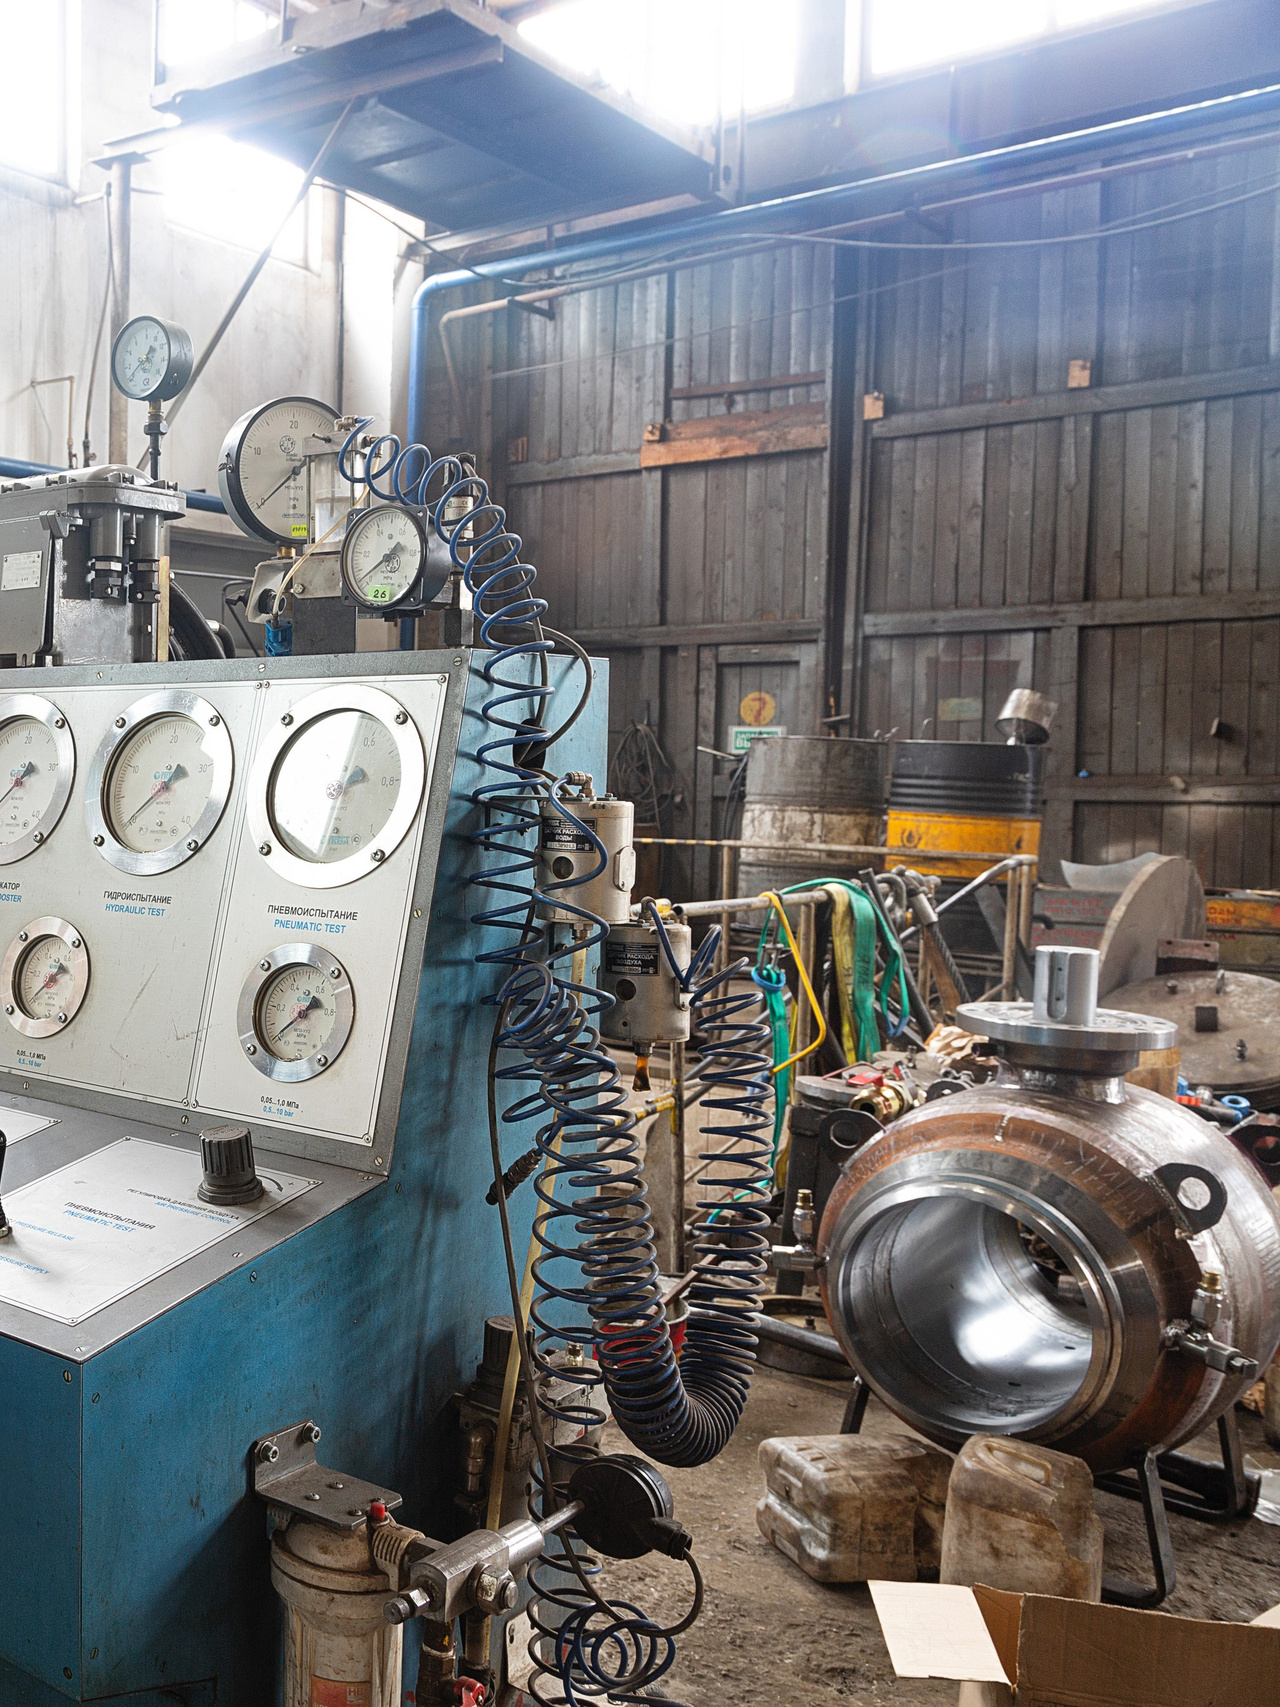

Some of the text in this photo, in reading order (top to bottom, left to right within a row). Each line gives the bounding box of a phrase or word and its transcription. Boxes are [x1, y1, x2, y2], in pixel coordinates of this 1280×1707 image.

[289, 420, 299, 429] 20
[253, 446, 261, 455] 10
[376, 528, 384, 537] 0,4
[398, 528, 407, 536] 0,6
[362, 550, 370, 559] 0,2
[409, 549, 417, 557] 0,8
[373, 589, 387, 598] 26
[25, 736, 32, 744] 20
[169, 734, 178, 744] 20
[363, 737, 376, 747] 0,6
[48, 763, 56, 771] 30
[132, 765, 139, 774] 10
[199, 764, 208, 773] 30
[381, 776, 395, 787] 0,8
[32, 810, 40, 819] 40
[181, 815, 191, 825] 40
[103, 890, 172, 905] ГИДРОИСПЫТАНИЕ
[104, 904, 166, 917] HYDRAULIC TEST
[267, 904, 359, 921] ПНЕВМОИСПЫТАНИЕ
[273, 918, 347, 934] PNEUMATIC TEST
[291, 983, 300, 992] 0,4
[316, 985, 325, 994] 0,6
[276, 1004, 286, 1012] 0,2
[324, 1008, 334, 1017] 0,8
[36, 1053, 46, 1061] МПа
[260, 1095, 300, 1109] 0,05...1,0 МПа
[284, 1110, 294, 1118] bar
[126, 1188, 241, 1221] РЕГУЛИРОВКА ДАВЛЕНИЯ ВОЗДУХА
[64, 1201, 156, 1230] ПНЕВМОИСПЫТАНИЯ
[166, 1204, 201, 1218] PRESSURE
[200, 1213, 232, 1225] CONTROL
[62, 1209, 136, 1233] PNEUMATIC TEST
[15, 1220, 75, 1242] PRESSURE RELEASE
[23, 1263, 50, 1275] SUPPLY
